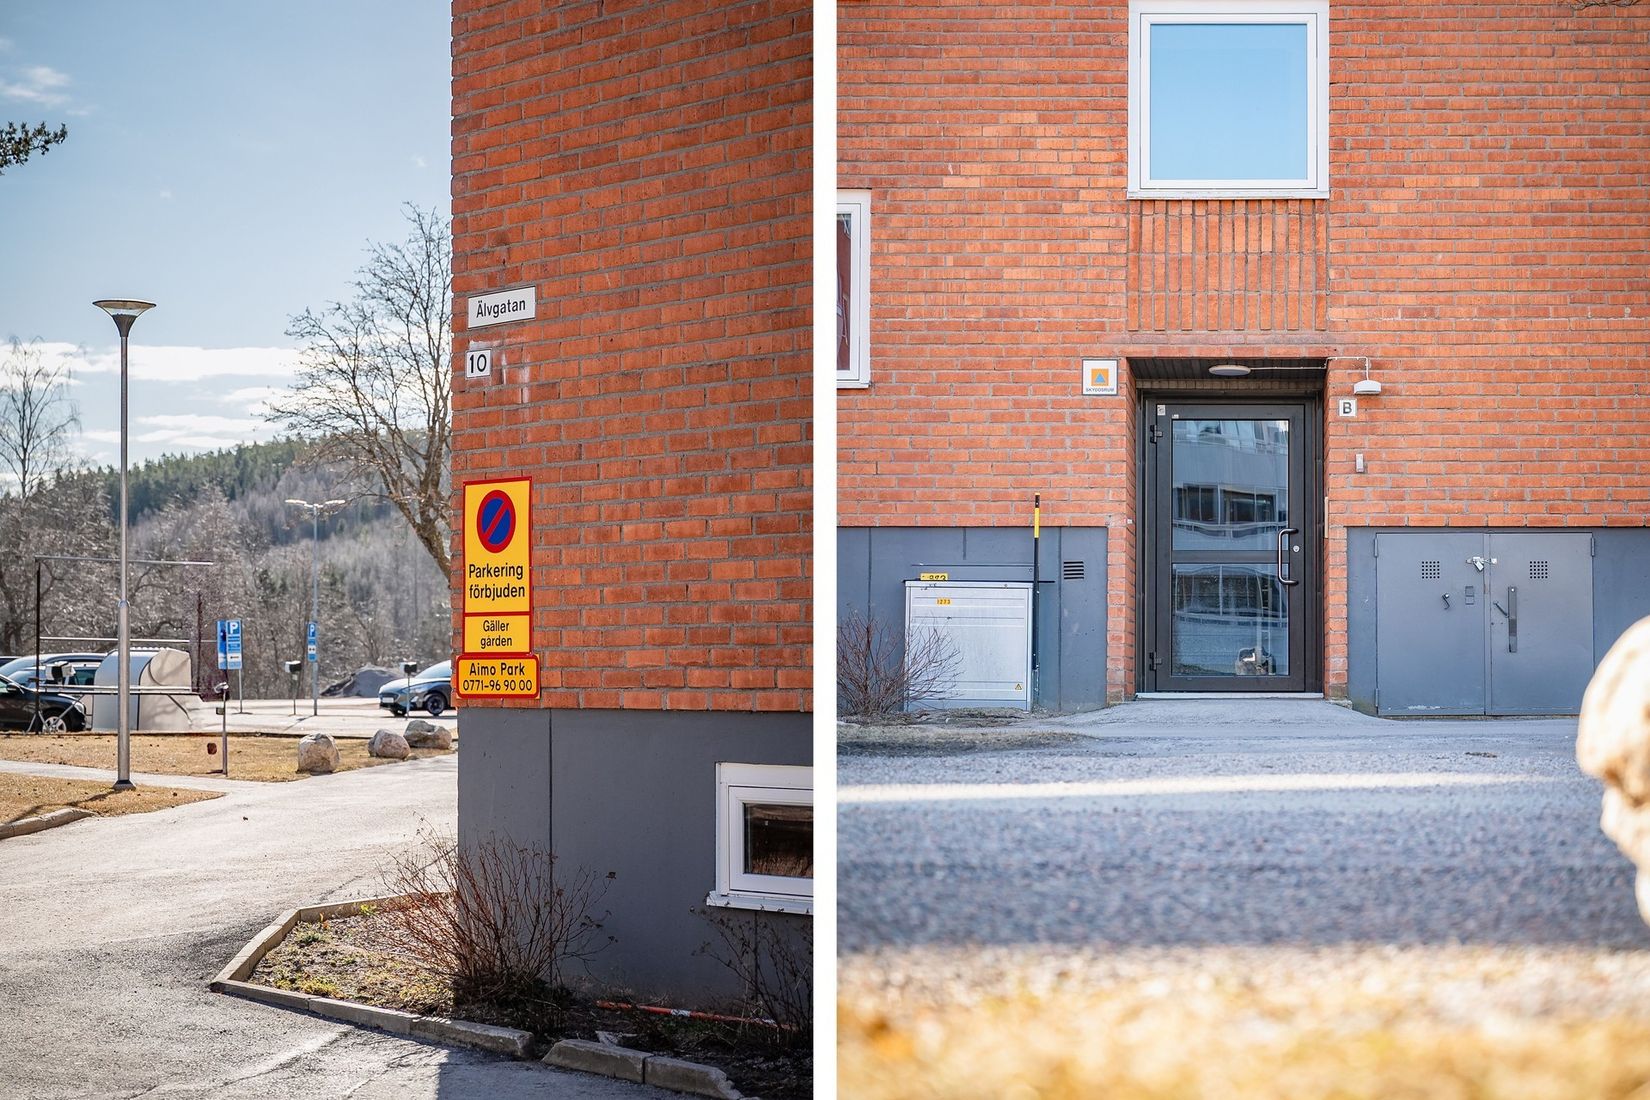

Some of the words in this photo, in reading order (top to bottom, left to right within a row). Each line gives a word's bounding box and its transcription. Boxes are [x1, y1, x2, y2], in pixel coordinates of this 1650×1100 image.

[476, 299, 526, 318] Älvgatan
[469, 354, 487, 373] 10
[1342, 401, 1353, 414] B
[469, 562, 523, 580] Parkering
[469, 583, 525, 601] förbjuden
[229, 621, 239, 635] P
[483, 620, 509, 632] Gäller
[480, 634, 512, 649] gården
[469, 662, 496, 676] Aimo
[500, 662, 525, 676] Park
[462, 679, 501, 691] 0771-96
[503, 679, 517, 691] 90
[518, 679, 533, 691] 00
